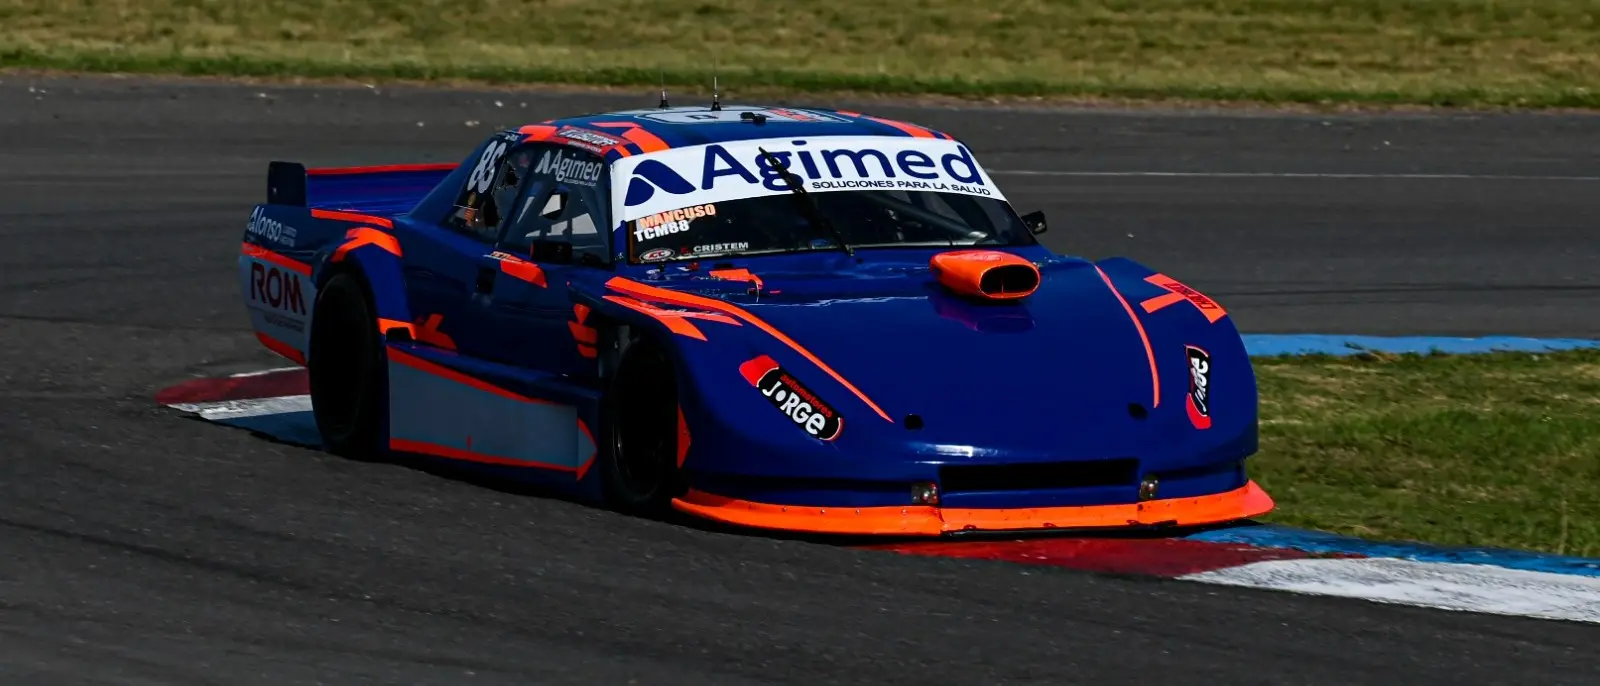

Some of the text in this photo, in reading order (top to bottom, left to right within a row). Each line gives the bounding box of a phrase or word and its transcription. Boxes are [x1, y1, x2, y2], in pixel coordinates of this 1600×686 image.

[548, 149, 603, 182] Agimed
[701, 140, 984, 191] Agimed
[812, 180, 991, 196] SOLUCIONES PARA LA SALUD
[247, 205, 282, 242] Alonso
[633, 220, 690, 242] TCM88
[638, 204, 716, 227] MANCUSO
[693, 242, 748, 252] CRISTEM
[251, 262, 306, 315] ROM
[780, 374, 833, 418] automotores
